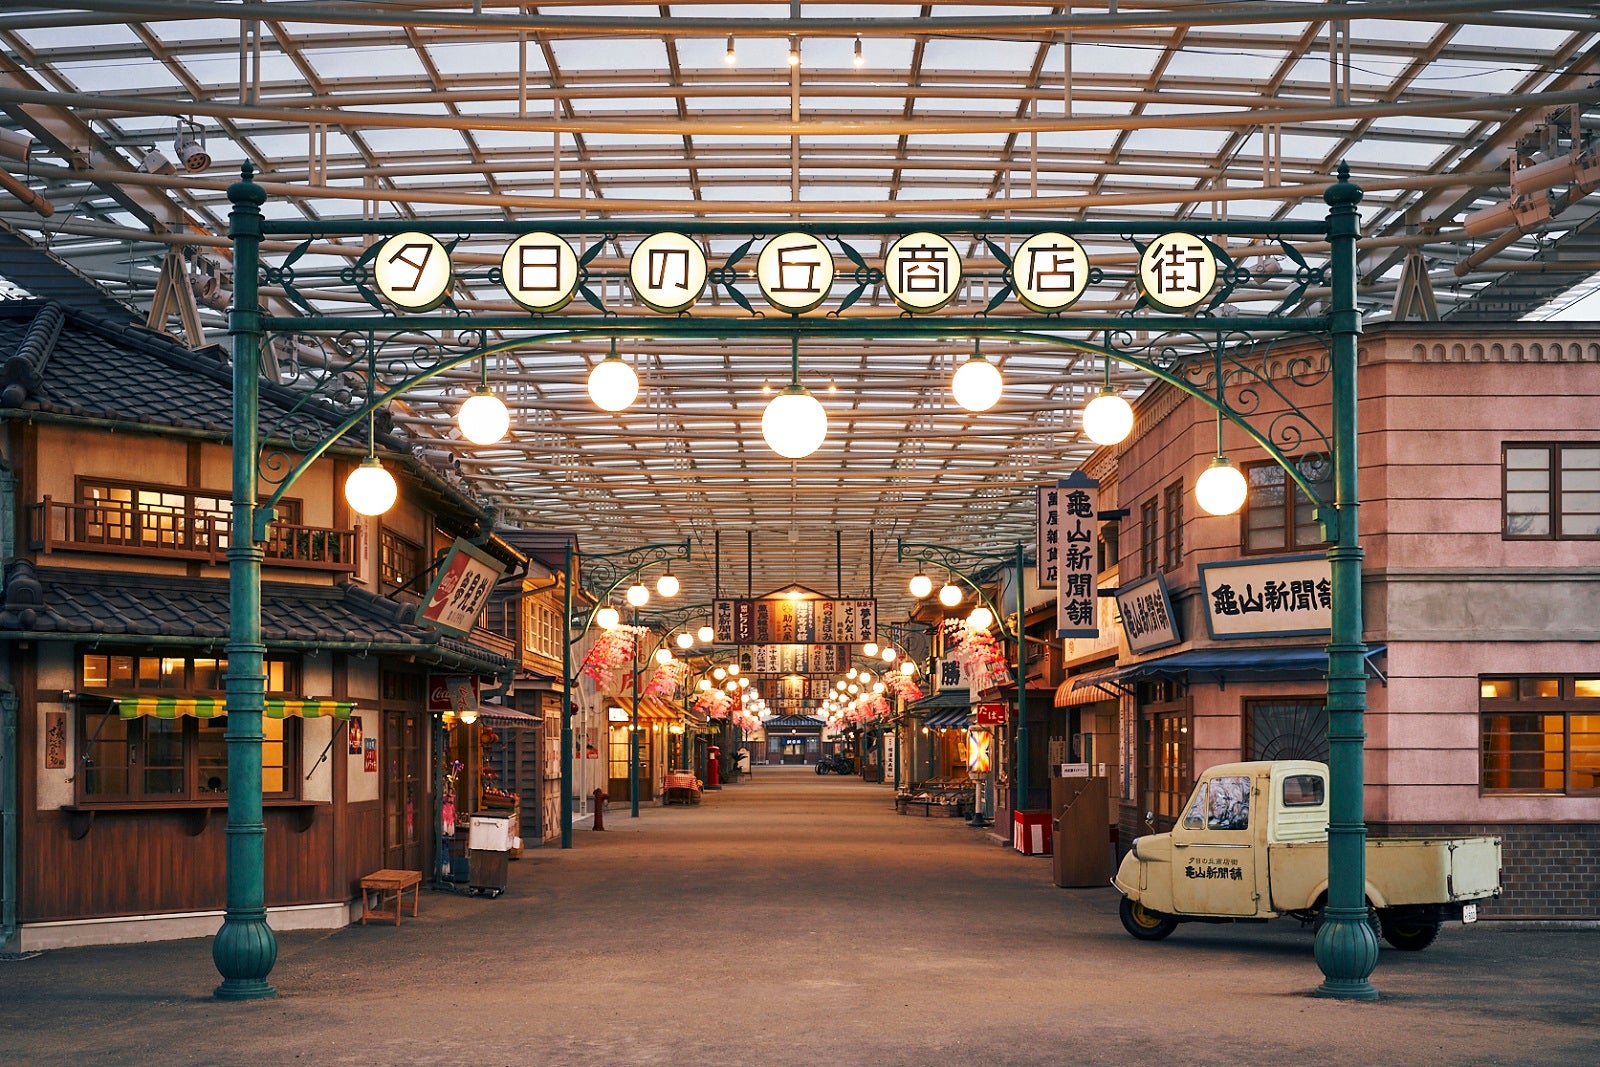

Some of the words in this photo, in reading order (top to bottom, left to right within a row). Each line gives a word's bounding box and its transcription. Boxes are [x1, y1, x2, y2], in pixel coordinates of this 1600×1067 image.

[388, 243, 1205, 296] 夕日の丘商店街
[860, 608, 872, 641] 夢見堂
